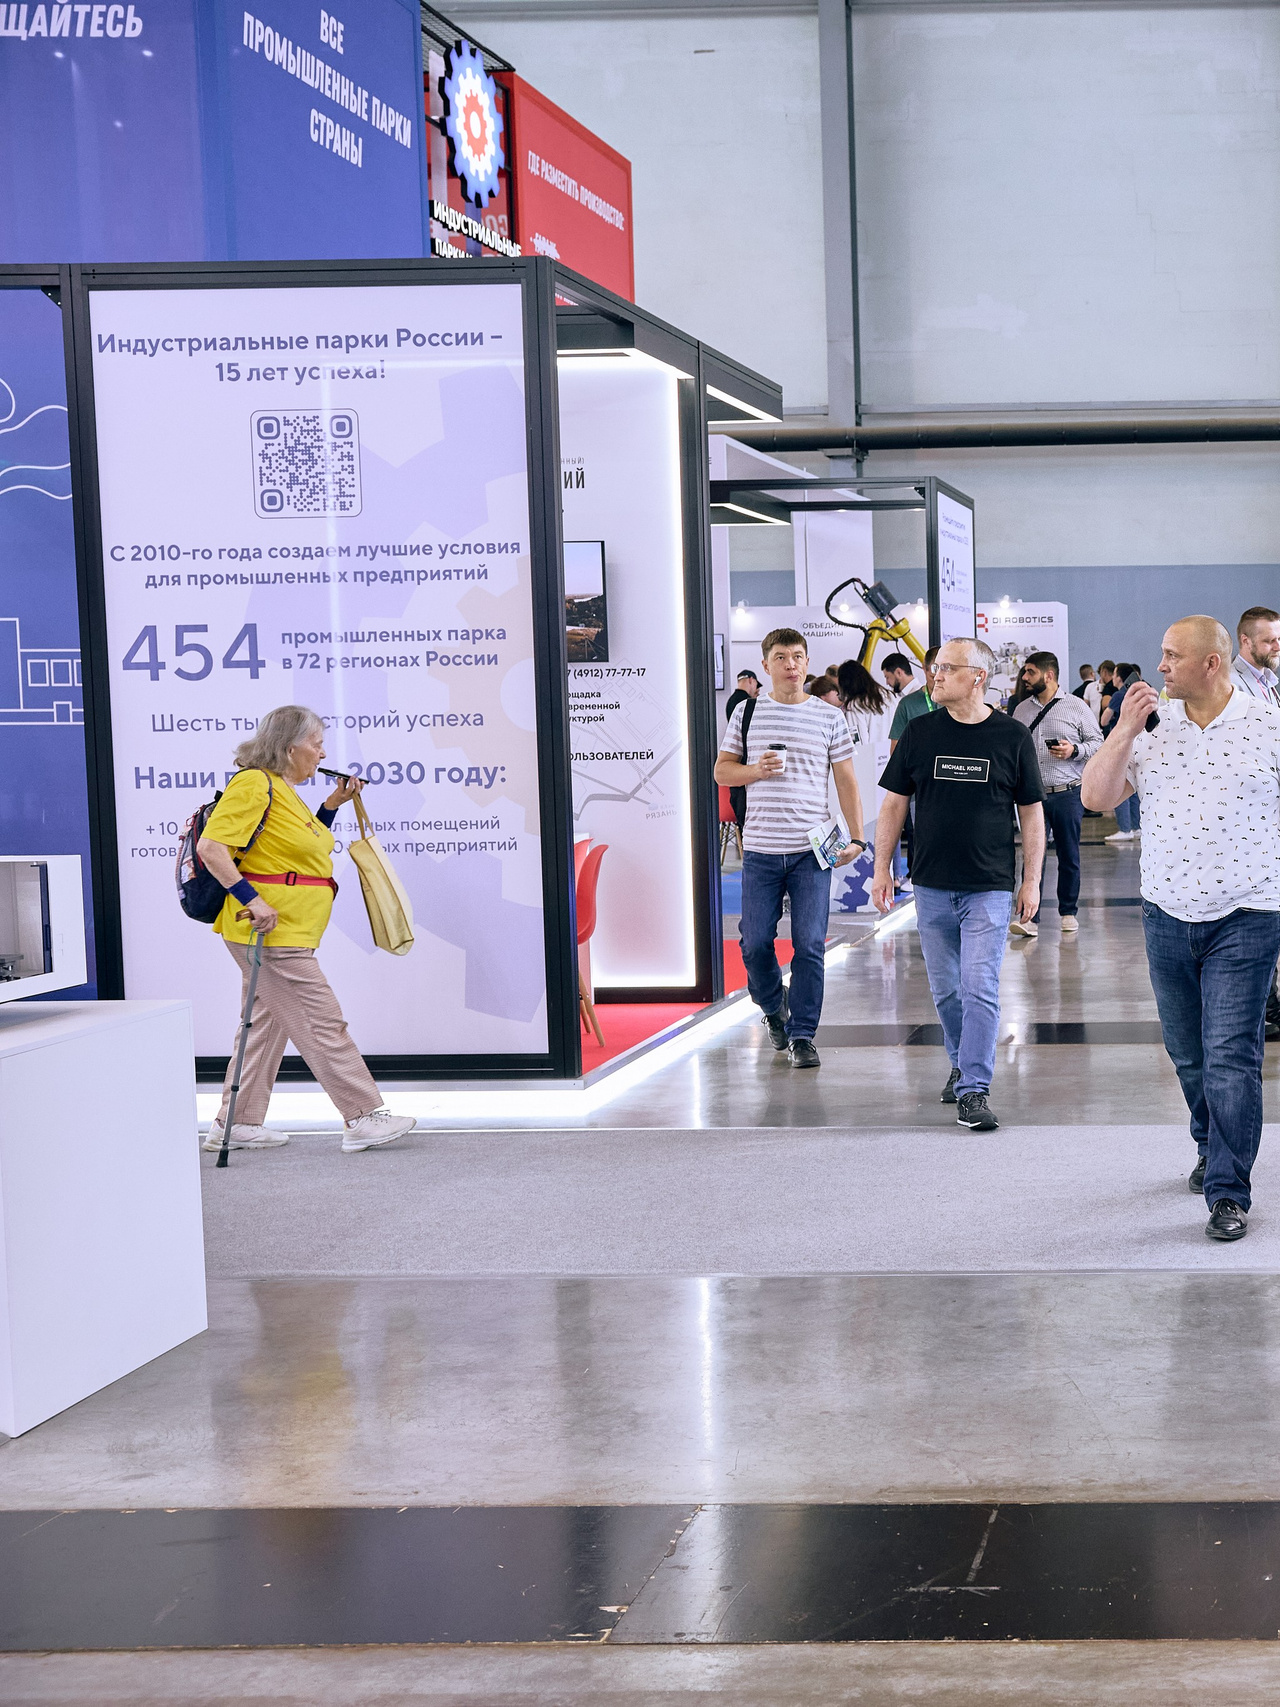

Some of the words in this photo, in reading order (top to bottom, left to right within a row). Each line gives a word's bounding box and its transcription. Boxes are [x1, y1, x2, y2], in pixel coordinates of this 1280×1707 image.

[0, 0, 143, 41] ЩАЙТЕСЬ
[320, 9, 344, 55] ВСЕ
[243, 11, 369, 122] ПРОМЫШЛЕННЫЕ
[371, 96, 412, 149] ПАРКИ
[310, 108, 363, 168] СТРАНЫ
[528, 150, 539, 177] ГДЕ
[541, 159, 579, 201] РАЗМЕСТИТЬ
[433, 200, 522, 257] ИНДУСТРИАЛЬНЫЕ
[97, 333, 309, 357] Индустриальные
[315, 331, 389, 352] парки
[396, 328, 485, 349] России
[215, 362, 242, 383] 15
[247, 365, 288, 383] лет
[294, 360, 386, 386] успеха!
[564, 467, 585, 489] ИЙ
[110, 545, 127, 562] С
[130, 543, 213, 562] 2010-го
[218, 546, 263, 565] года
[267, 545, 350, 563] создаем
[355, 542, 433, 562] лучшие
[438, 541, 521, 560] условия
[145, 570, 181, 589] для
[186, 567, 348, 588] промышленных
[353, 563, 488, 588] предприятий
[942, 556, 955, 593] 454
[1005, 616, 1055, 625] ROBOTICS
[281, 627, 442, 650] промышленных
[446, 625, 507, 645] парка
[121, 623, 267, 683] 454
[281, 654, 292, 669] в
[296, 652, 321, 669] 72
[326, 652, 421, 673] регионах
[426, 648, 499, 668] России
[573, 668, 604, 680] (4912)
[606, 667, 646, 677] 77-77-17
[152, 713, 226, 733] Шесть
[322, 713, 403, 734] сторий
[407, 710, 485, 733] успеха
[134, 766, 216, 789] Наши
[346, 761, 425, 786] 2030
[435, 762, 507, 790] году:
[941, 763, 966, 771] MICHAEL
[400, 815, 501, 834] помещений
[131, 846, 177, 858] готов
[404, 838, 518, 857] предприятий
